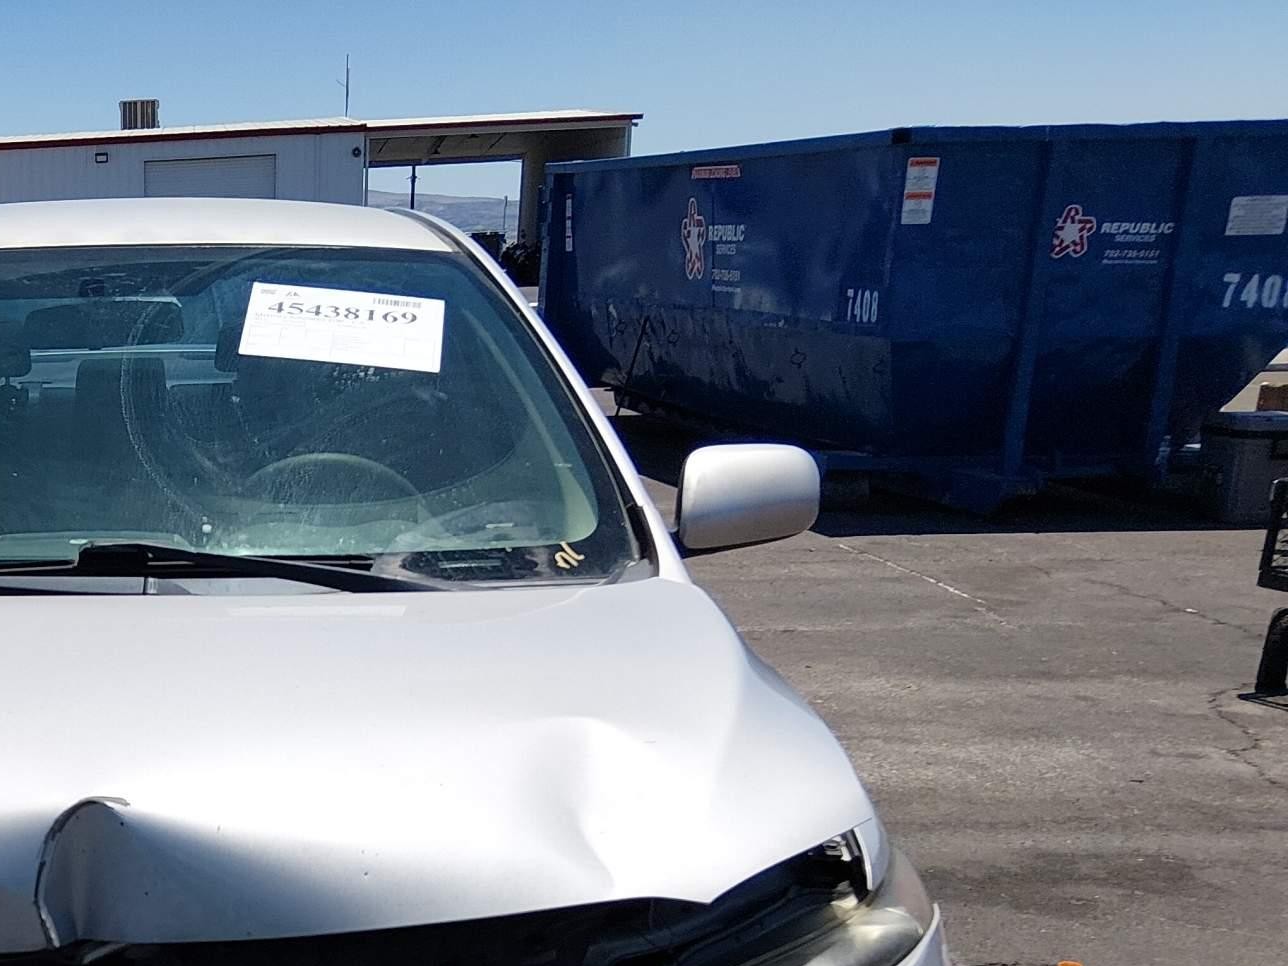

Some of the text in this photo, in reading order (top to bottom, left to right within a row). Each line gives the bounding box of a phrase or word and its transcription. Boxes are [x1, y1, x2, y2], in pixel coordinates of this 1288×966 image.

[708, 224, 745, 242] REPUBLIC
[1100, 222, 1175, 234] REPUBLIC
[267, 300, 418, 325] 45438169
[847, 288, 879, 323] 7408
